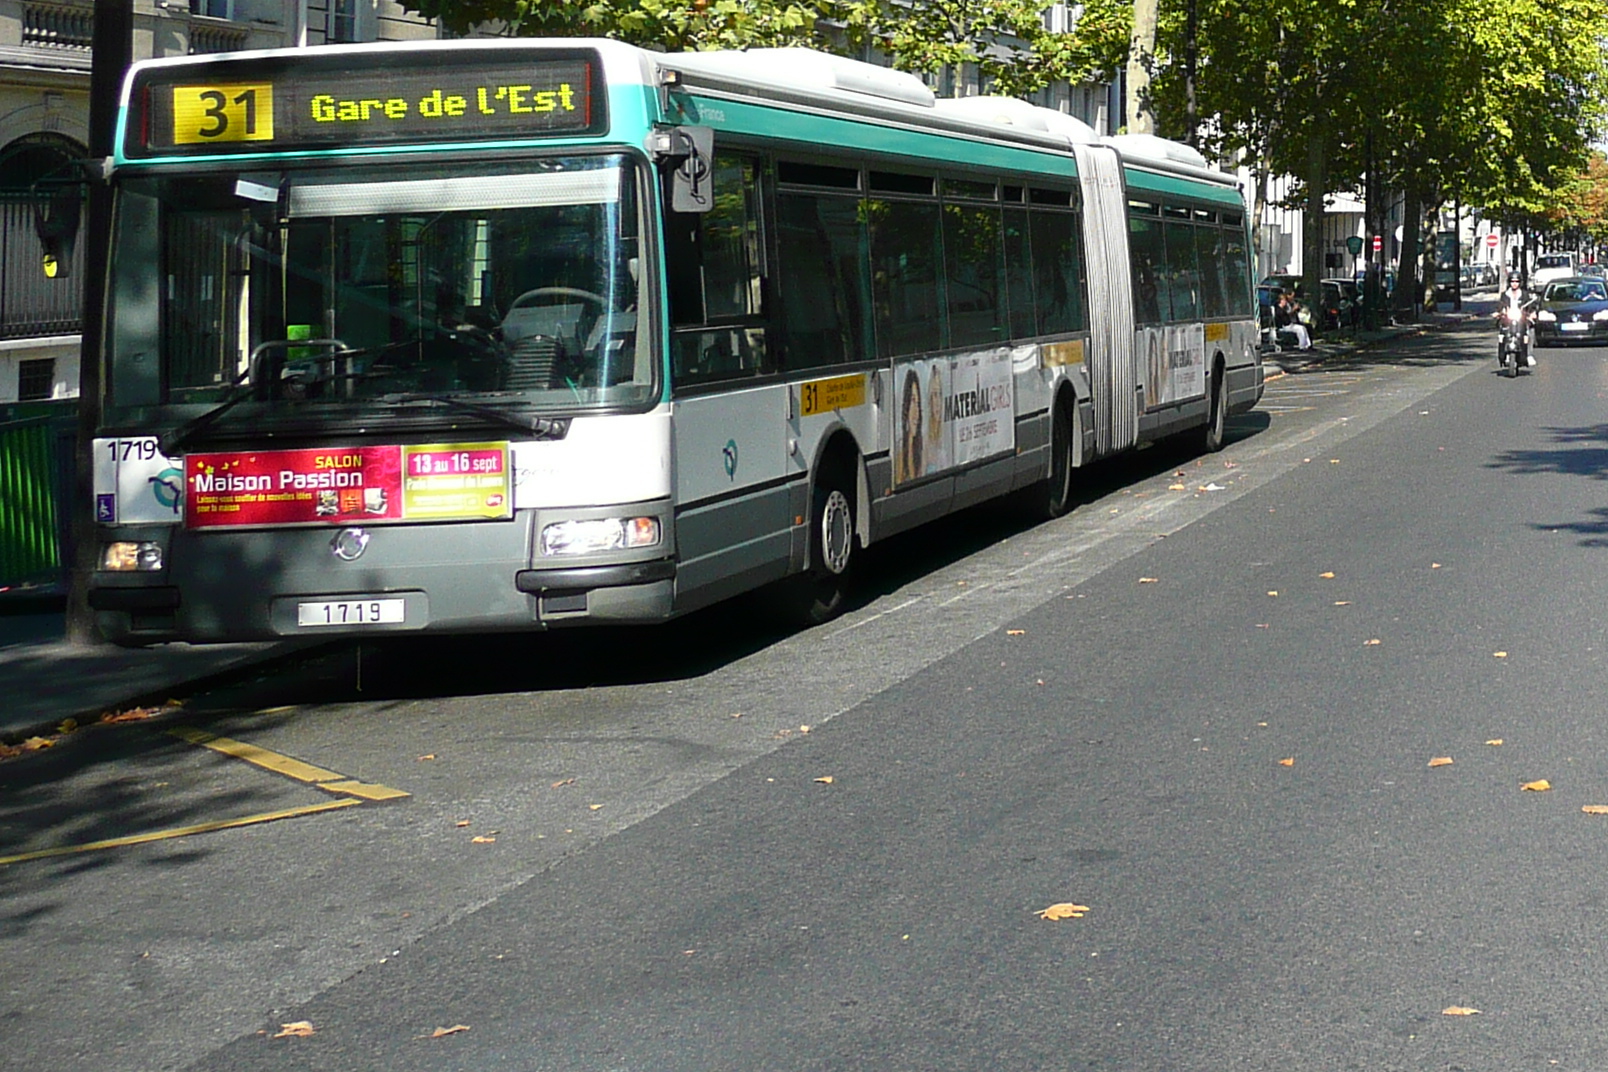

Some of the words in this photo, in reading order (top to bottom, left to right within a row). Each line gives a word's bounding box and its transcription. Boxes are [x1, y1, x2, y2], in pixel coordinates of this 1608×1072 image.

[199, 89, 257, 137] 31
[311, 95, 408, 122] Gare
[418, 89, 467, 118] de
[478, 83, 576, 115] l'Est
[805, 384, 818, 413] 31
[944, 373, 990, 422] MATERIAL
[108, 440, 156, 461] 1719
[315, 455, 362, 470] SALON
[413, 454, 432, 473] 13
[434, 459, 448, 472] au
[451, 453, 469, 472] 16
[473, 456, 497, 474] sept
[195, 473, 271, 492] Maison
[279, 469, 363, 490] Passion
[323, 602, 380, 623] 1719
